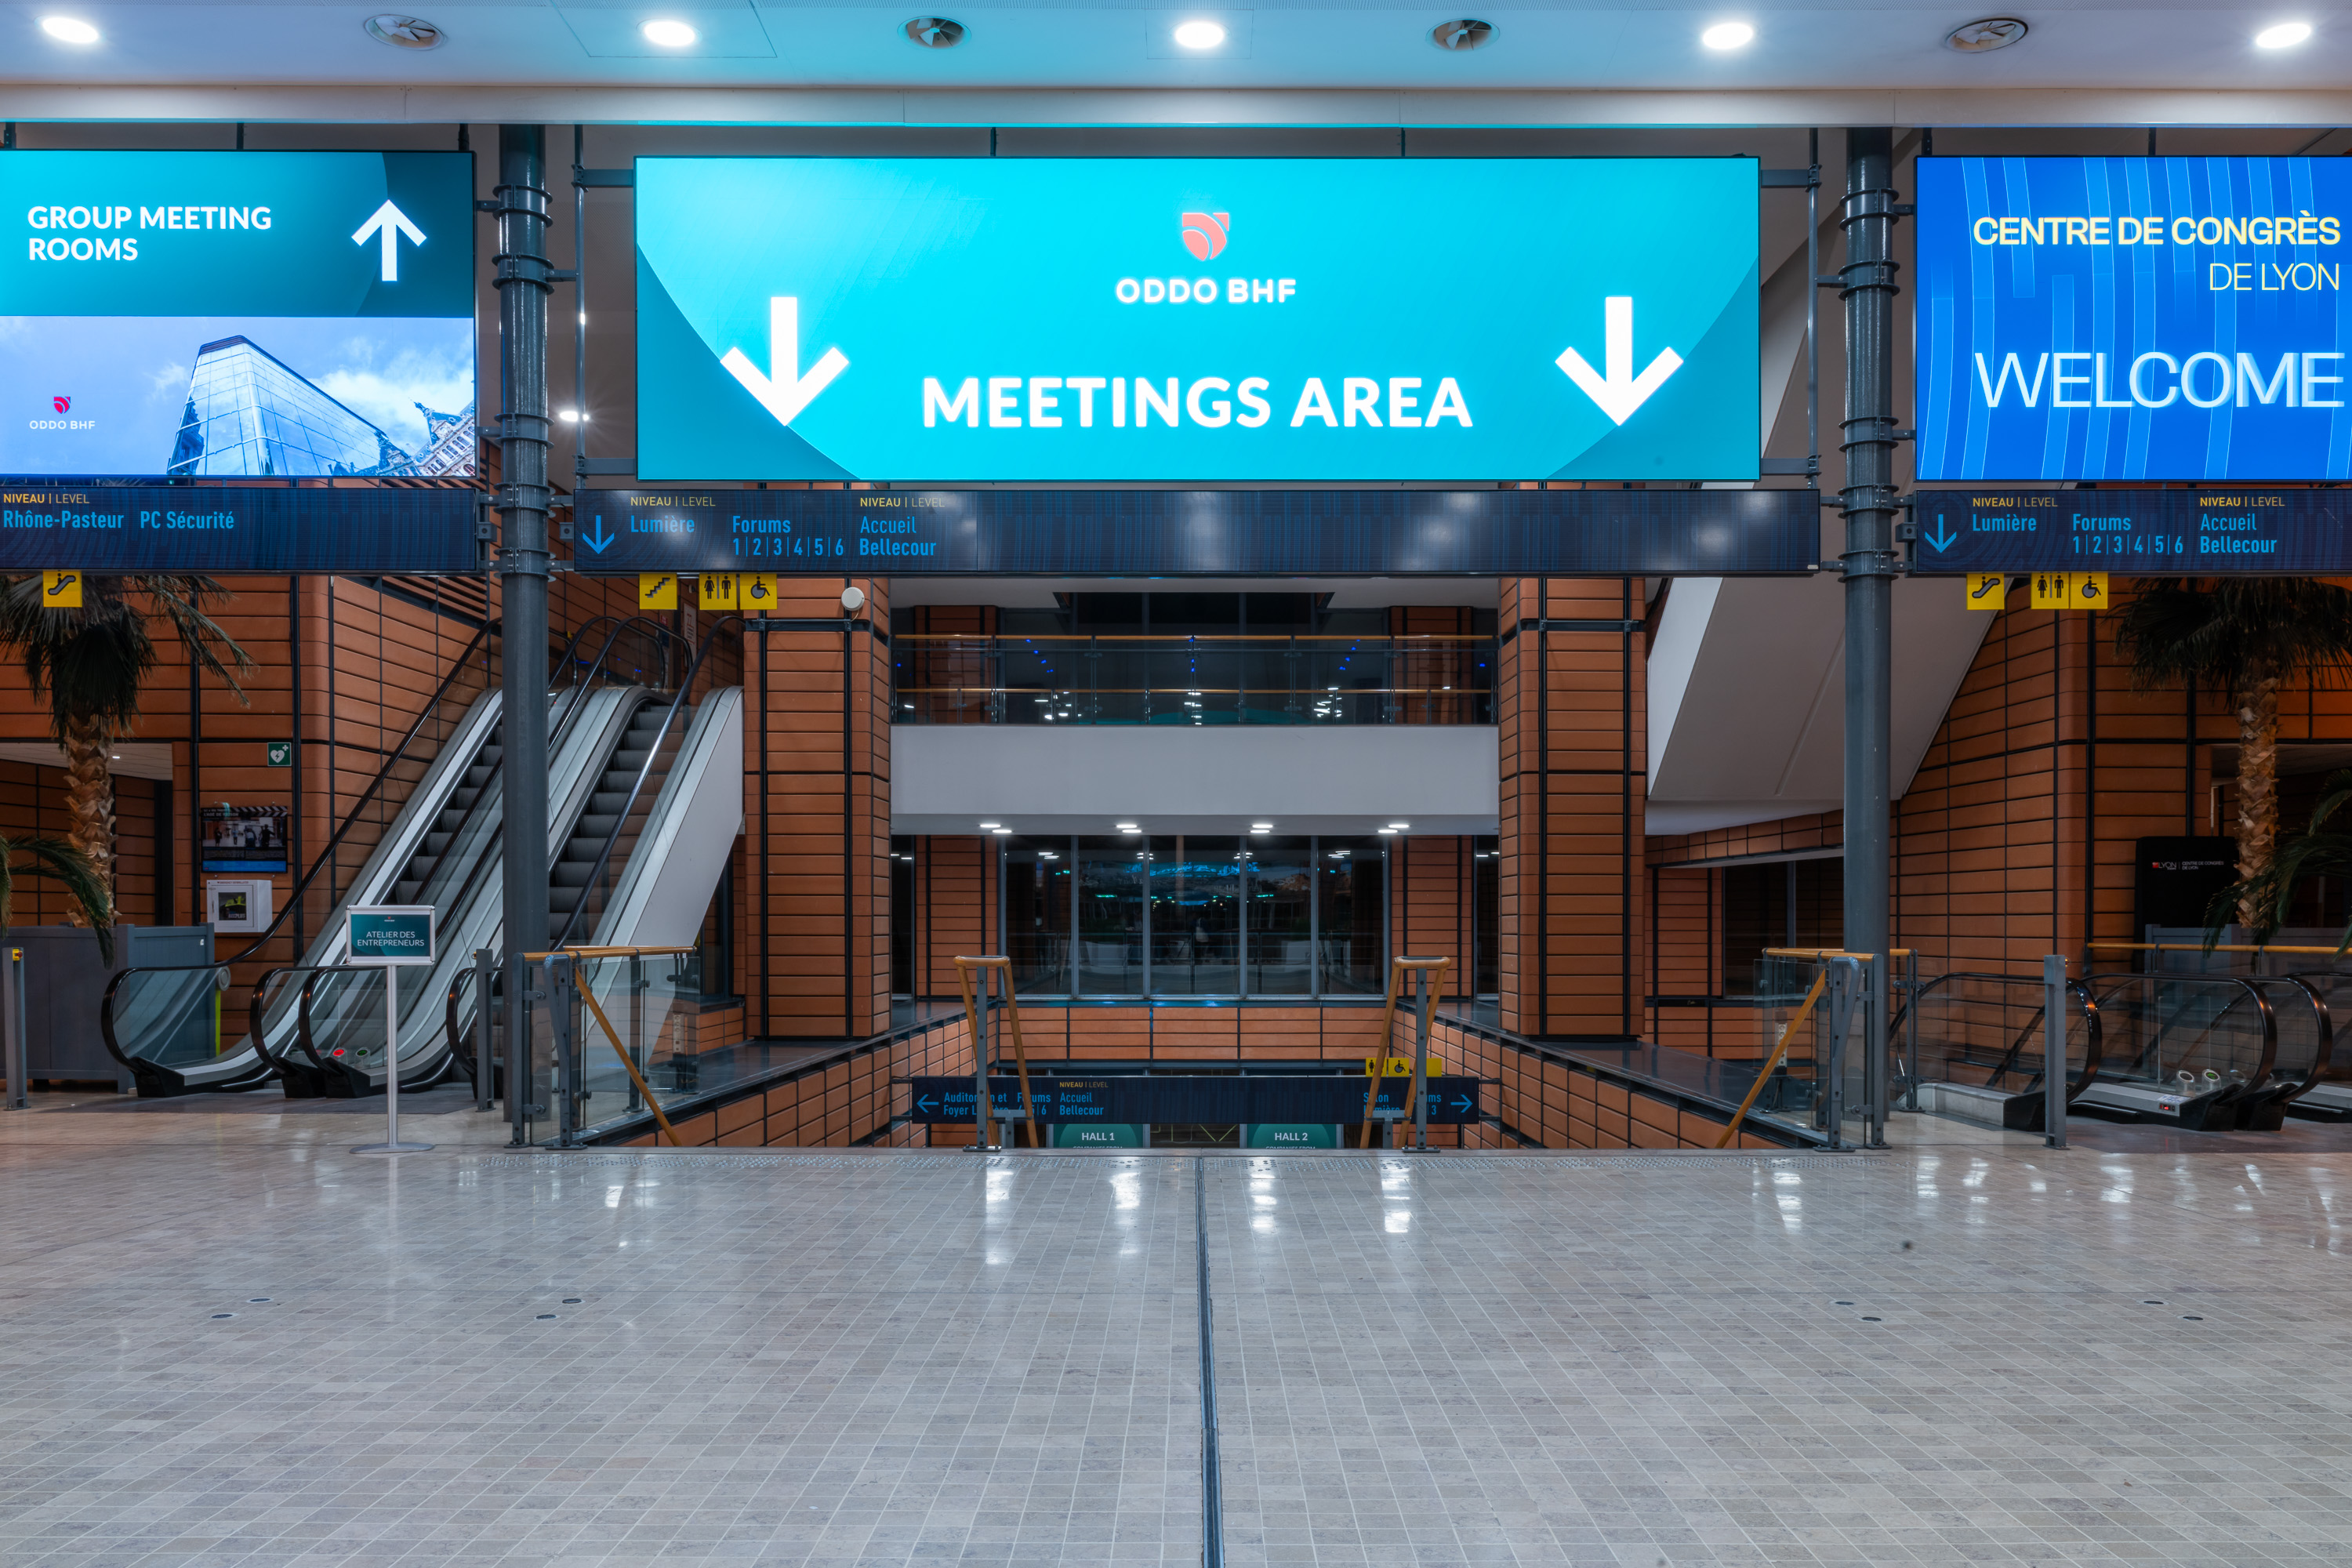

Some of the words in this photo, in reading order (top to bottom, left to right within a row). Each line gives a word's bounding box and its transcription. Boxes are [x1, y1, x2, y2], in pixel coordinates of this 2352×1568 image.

[28, 206, 132, 229] GROUP
[140, 206, 271, 230] MEETING
[1973, 216, 2110, 245] CENTRE
[2118, 217, 2164, 245] DE
[2172, 210, 2341, 245] CONGRÈS
[29, 238, 138, 260] ROOMS
[2209, 263, 2252, 291] DE
[2261, 263, 2339, 291] LYON
[1116, 278, 1218, 303] ODDO
[1228, 278, 1296, 303] BHF
[1972, 350, 2345, 408] WELCOME
[923, 377, 1271, 428] MEETINGS
[1290, 377, 1473, 427] AREA
[29, 420, 67, 430] ODDO
[70, 420, 96, 430] BHF
[3, 493, 45, 504] NIVEAU
[56, 494, 90, 504] LEVEL
[630, 496, 671, 506] NIVEAU
[682, 496, 716, 507] LEVEL
[860, 497, 901, 507] NIVEAU
[912, 497, 946, 508] LEVEL
[1973, 497, 2014, 507] NIVEAU
[2024, 497, 2058, 507] LEVEL
[2200, 496, 2241, 507] NIVEAU
[2251, 496, 2285, 507] LEVEL
[3, 510, 125, 529] Rhône-Pasteur
[140, 510, 162, 529] PC
[166, 510, 234, 529] Sécurité
[630, 514, 695, 533] Lumière
[732, 515, 791, 534] Forums
[859, 515, 917, 534] Accueil
[1973, 514, 2037, 532] Lumière
[2072, 514, 2132, 532] Forums
[2200, 514, 2257, 532] Accueil
[859, 538, 937, 557] Bellecour
[2200, 535, 2278, 554] Bellecour
[998, 1093, 1007, 1103] et
[1060, 1092, 1093, 1103] Accueil
[943, 1105, 969, 1117] Foyer
[1059, 1105, 1104, 1116] Bellecour
[1081, 1132, 1107, 1141] HALL
[1109, 1132, 1115, 1141] 1
[1274, 1132, 1300, 1141] HALL
[1301, 1132, 1308, 1141] 2
